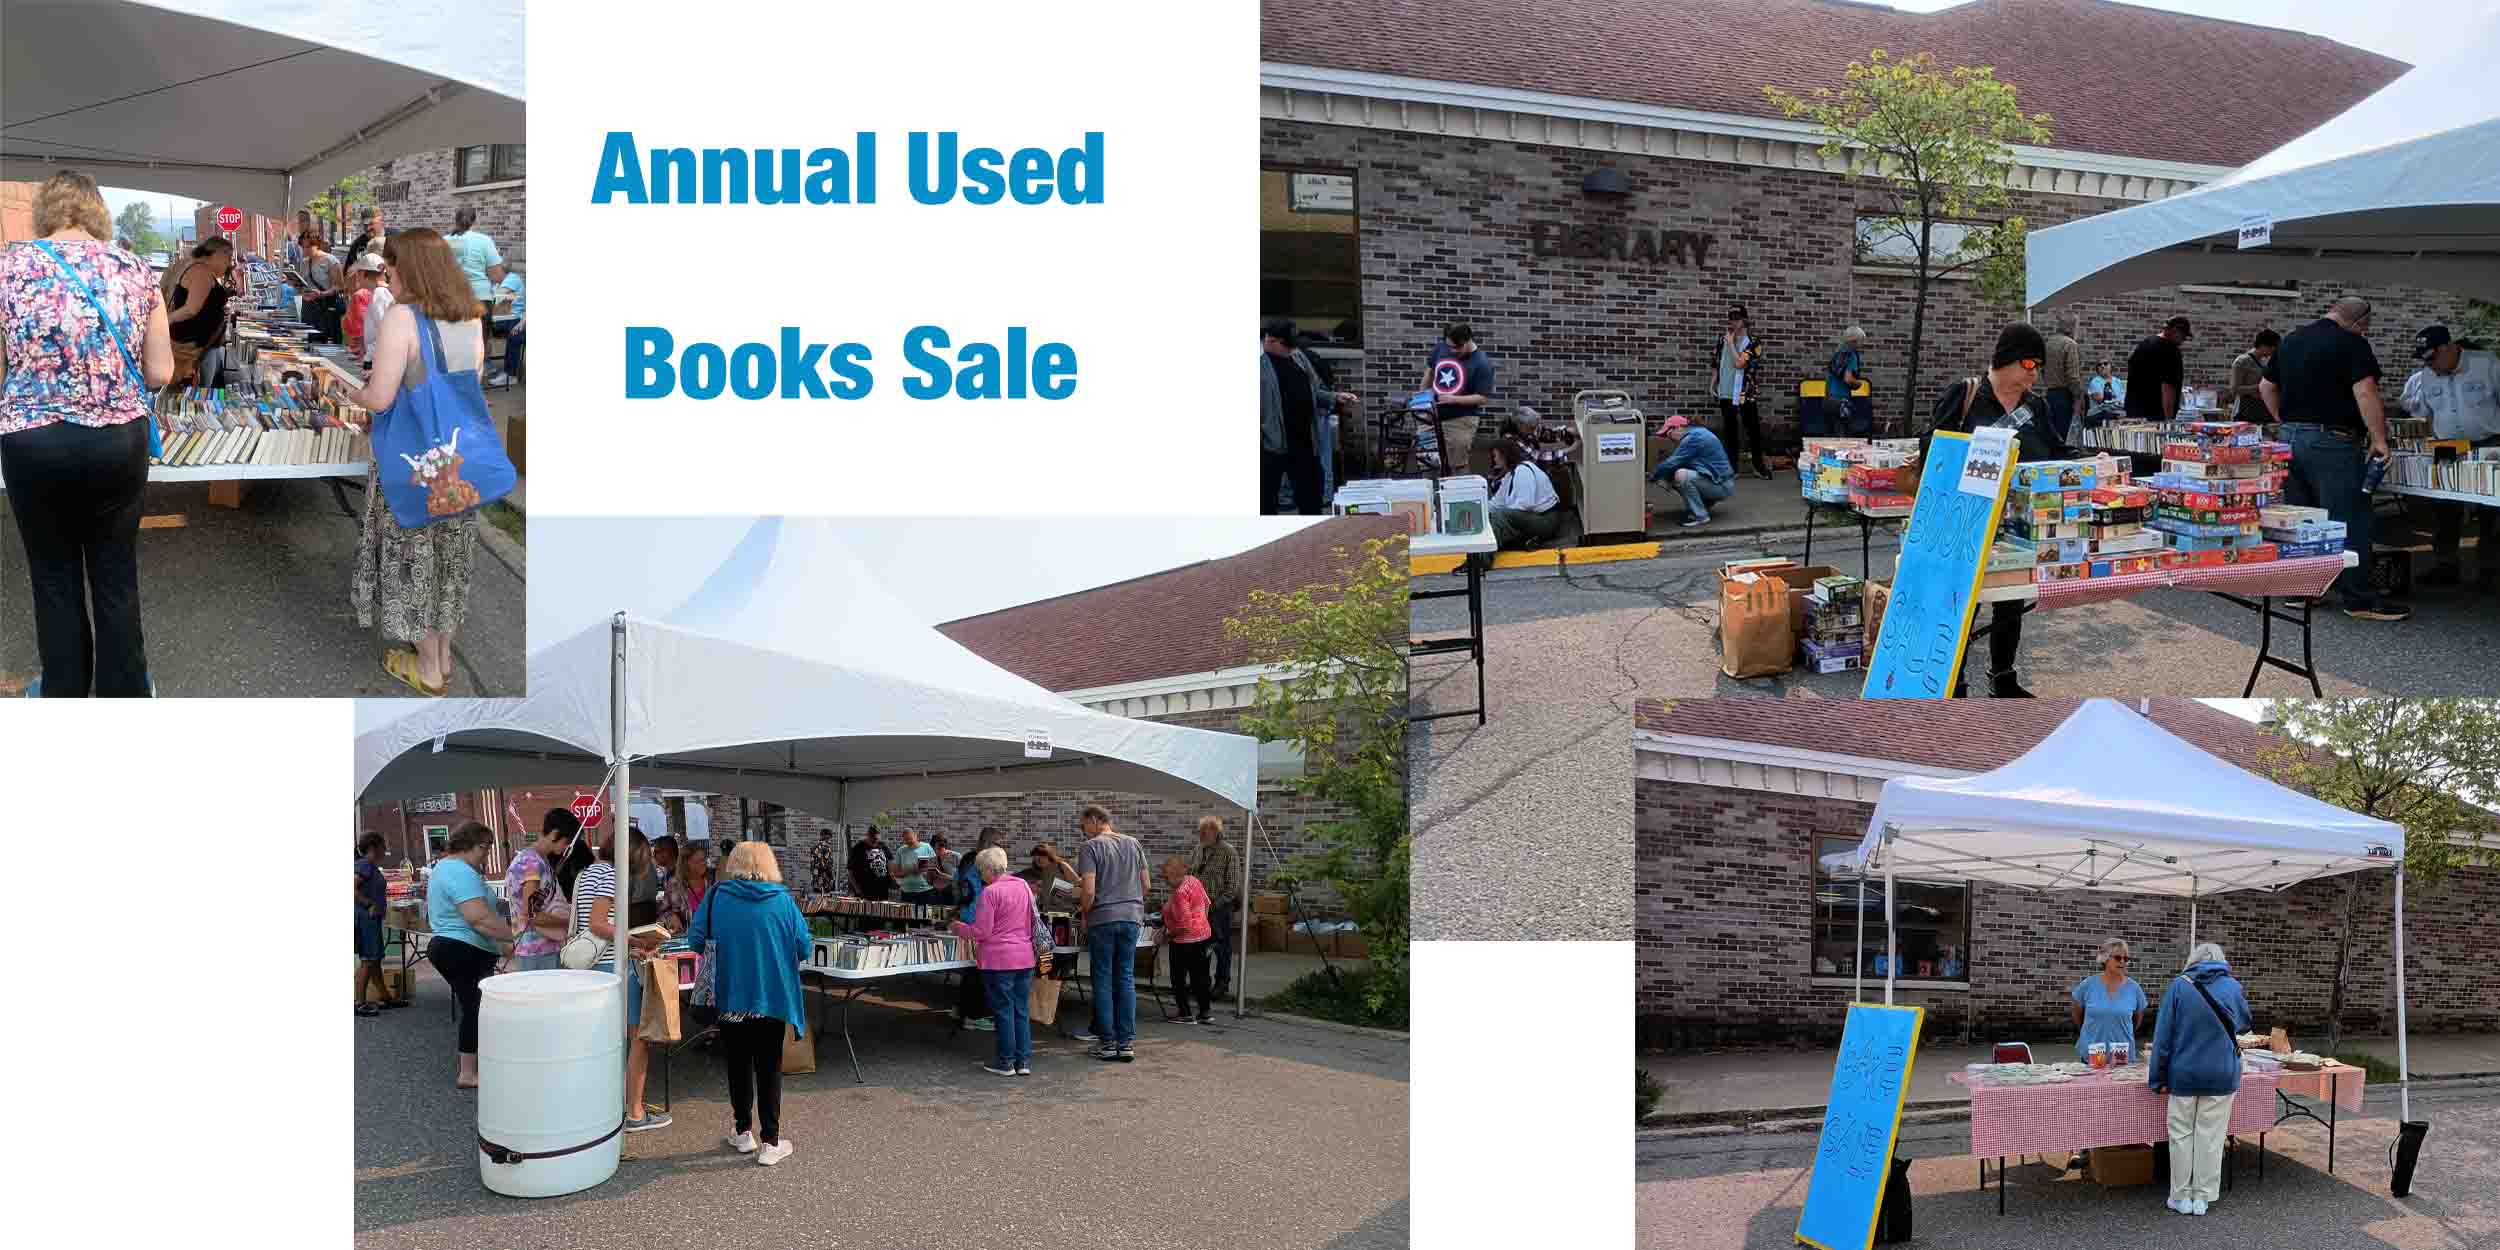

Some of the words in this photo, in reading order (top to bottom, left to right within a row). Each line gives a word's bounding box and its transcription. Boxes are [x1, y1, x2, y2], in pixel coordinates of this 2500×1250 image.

[220, 213, 241, 224] STOP
[1533, 222, 1714, 268] LIBRARY
[574, 805, 601, 818] STOP
